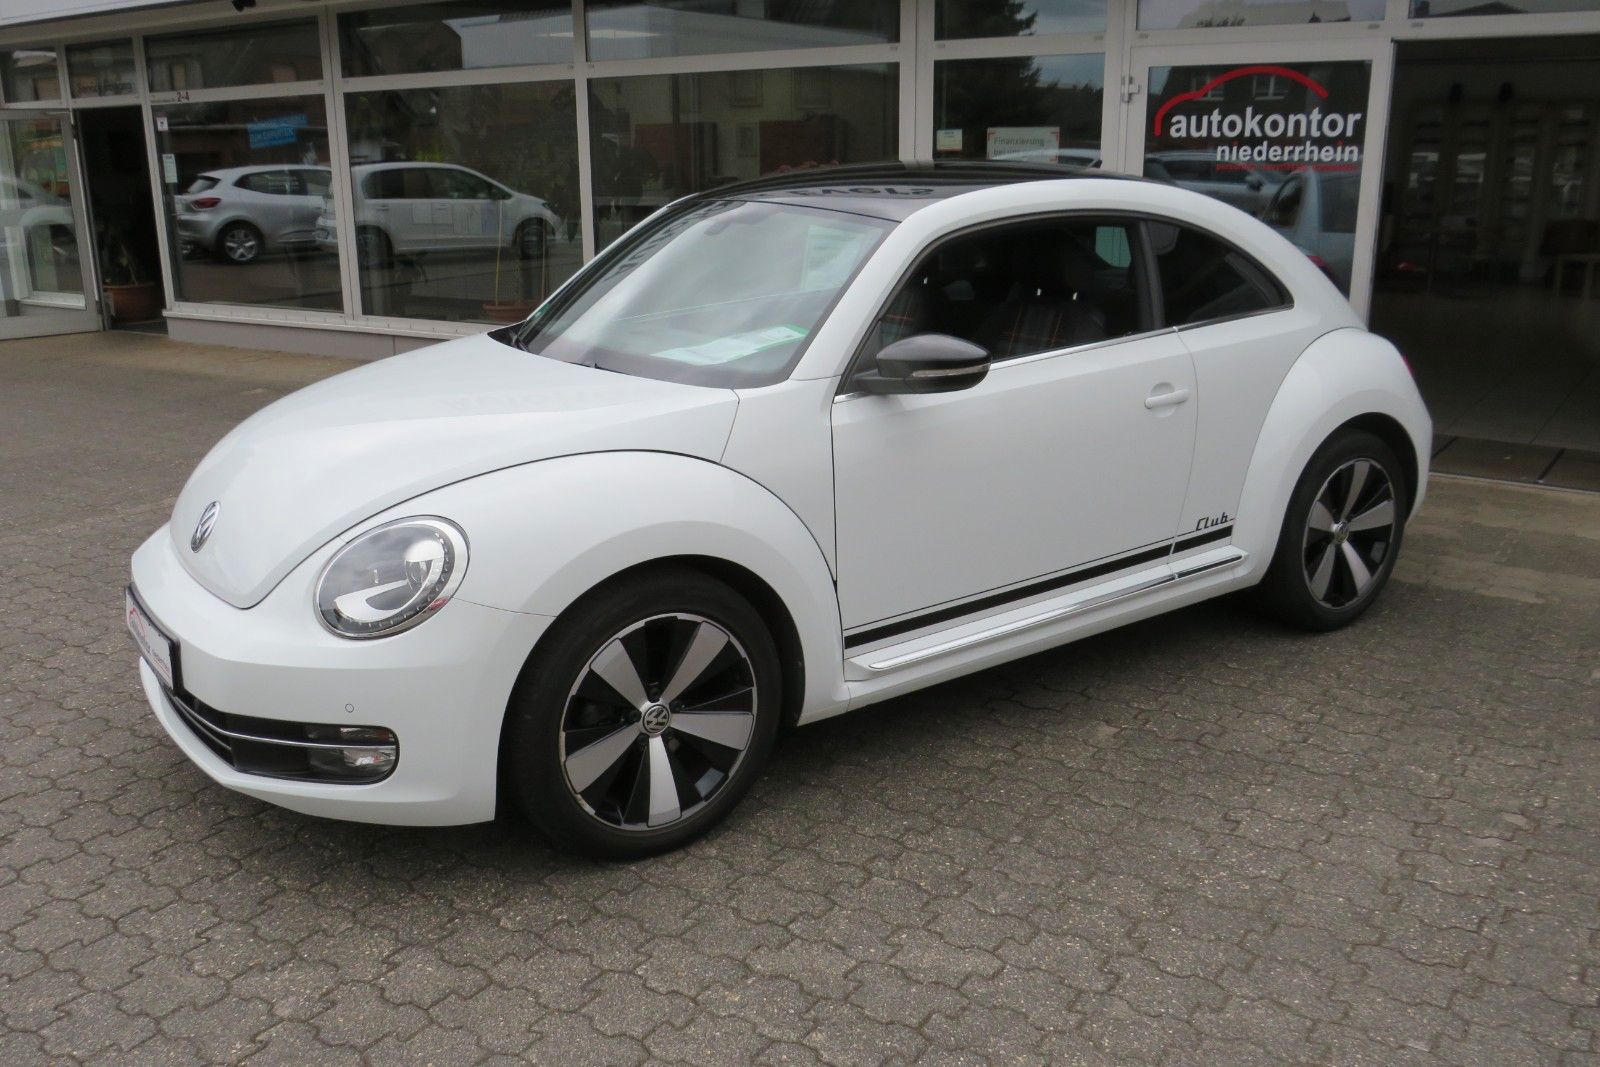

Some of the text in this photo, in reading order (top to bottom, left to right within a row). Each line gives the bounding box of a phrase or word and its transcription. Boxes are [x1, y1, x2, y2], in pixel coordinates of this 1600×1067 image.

[1169, 106, 1361, 137] autokontor
[1216, 140, 1359, 162] niederrhein
[1195, 511, 1229, 532] Club
